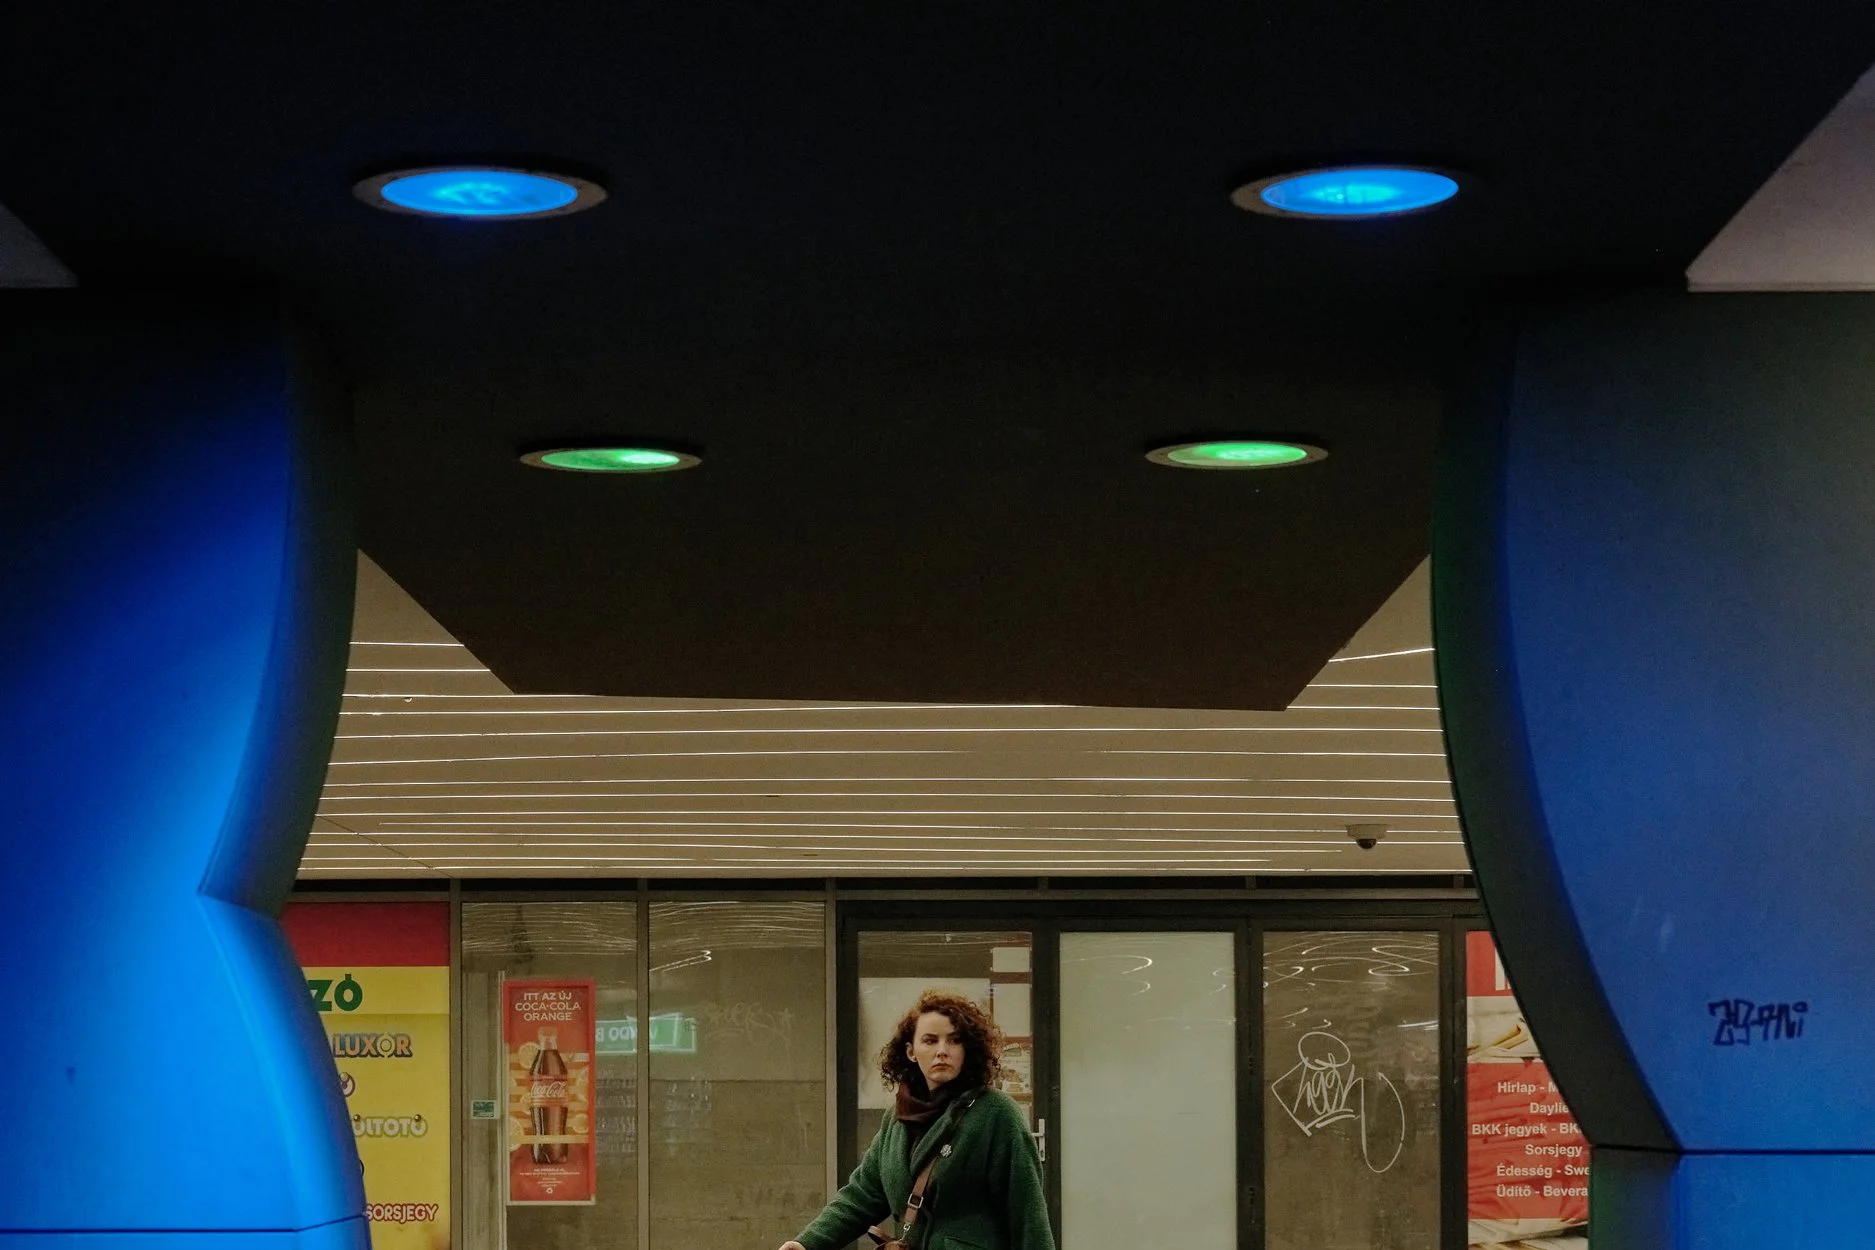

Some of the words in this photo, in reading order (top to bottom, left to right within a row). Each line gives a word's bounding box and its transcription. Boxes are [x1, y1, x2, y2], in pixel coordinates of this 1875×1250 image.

[524, 992, 540, 1001] ITT
[542, 992, 556, 1001] AZ
[558, 990, 572, 1001] ÚJ
[524, 1012, 573, 1021] ORANGE
[1472, 1124, 1501, 1135] BKK
[1504, 1123, 1548, 1138] jegyek
[1525, 1143, 1583, 1158] Sorsjegy
[1496, 1161, 1553, 1179] Édesség
